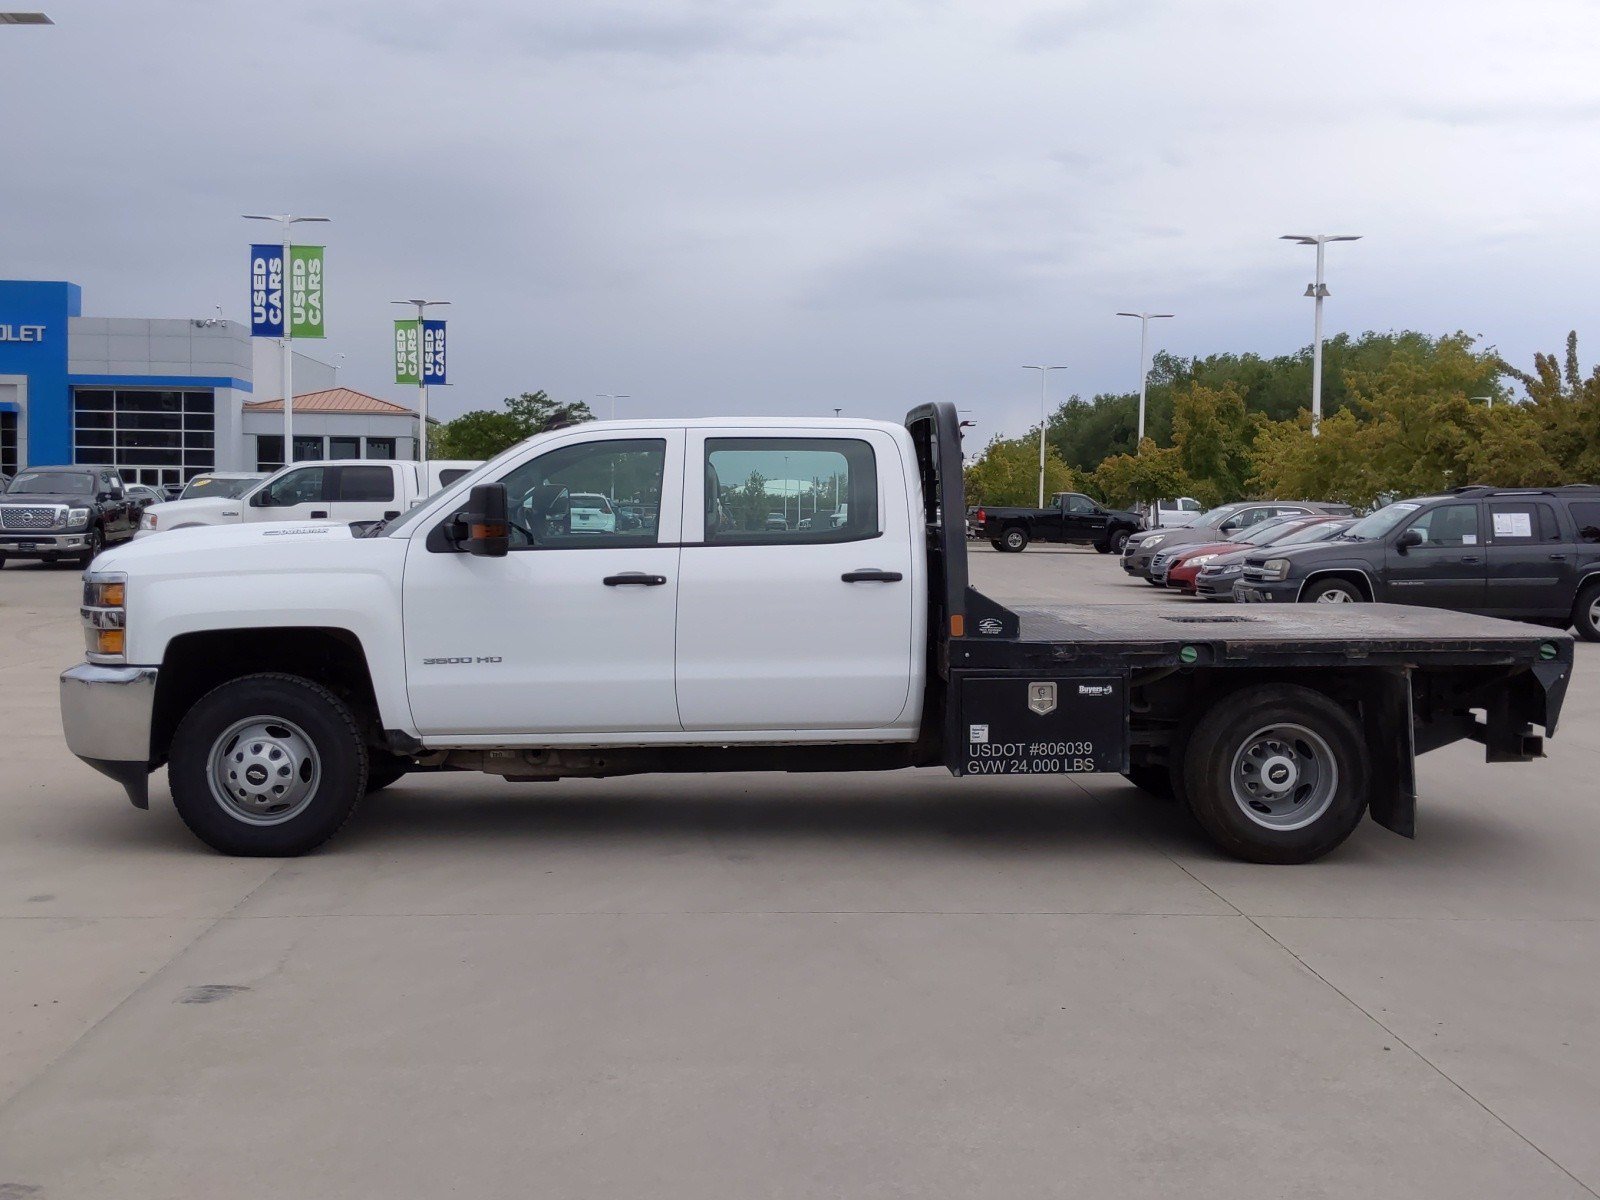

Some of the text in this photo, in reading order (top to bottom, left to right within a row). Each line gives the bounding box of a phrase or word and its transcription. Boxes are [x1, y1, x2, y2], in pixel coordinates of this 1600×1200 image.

[253, 257, 267, 324] USED
[268, 257, 282, 325] CARS
[292, 258, 306, 325] USED
[307, 258, 321, 326] CARS
[396, 329, 407, 376] USED
[407, 328, 418, 376] CARS
[424, 329, 434, 376] USED
[435, 328, 445, 377] CARS
[476, 656, 502, 664] HD
[967, 758, 1094, 774] GVW 24,000 LBS
[969, 741, 1093, 758] USDOT #806039
